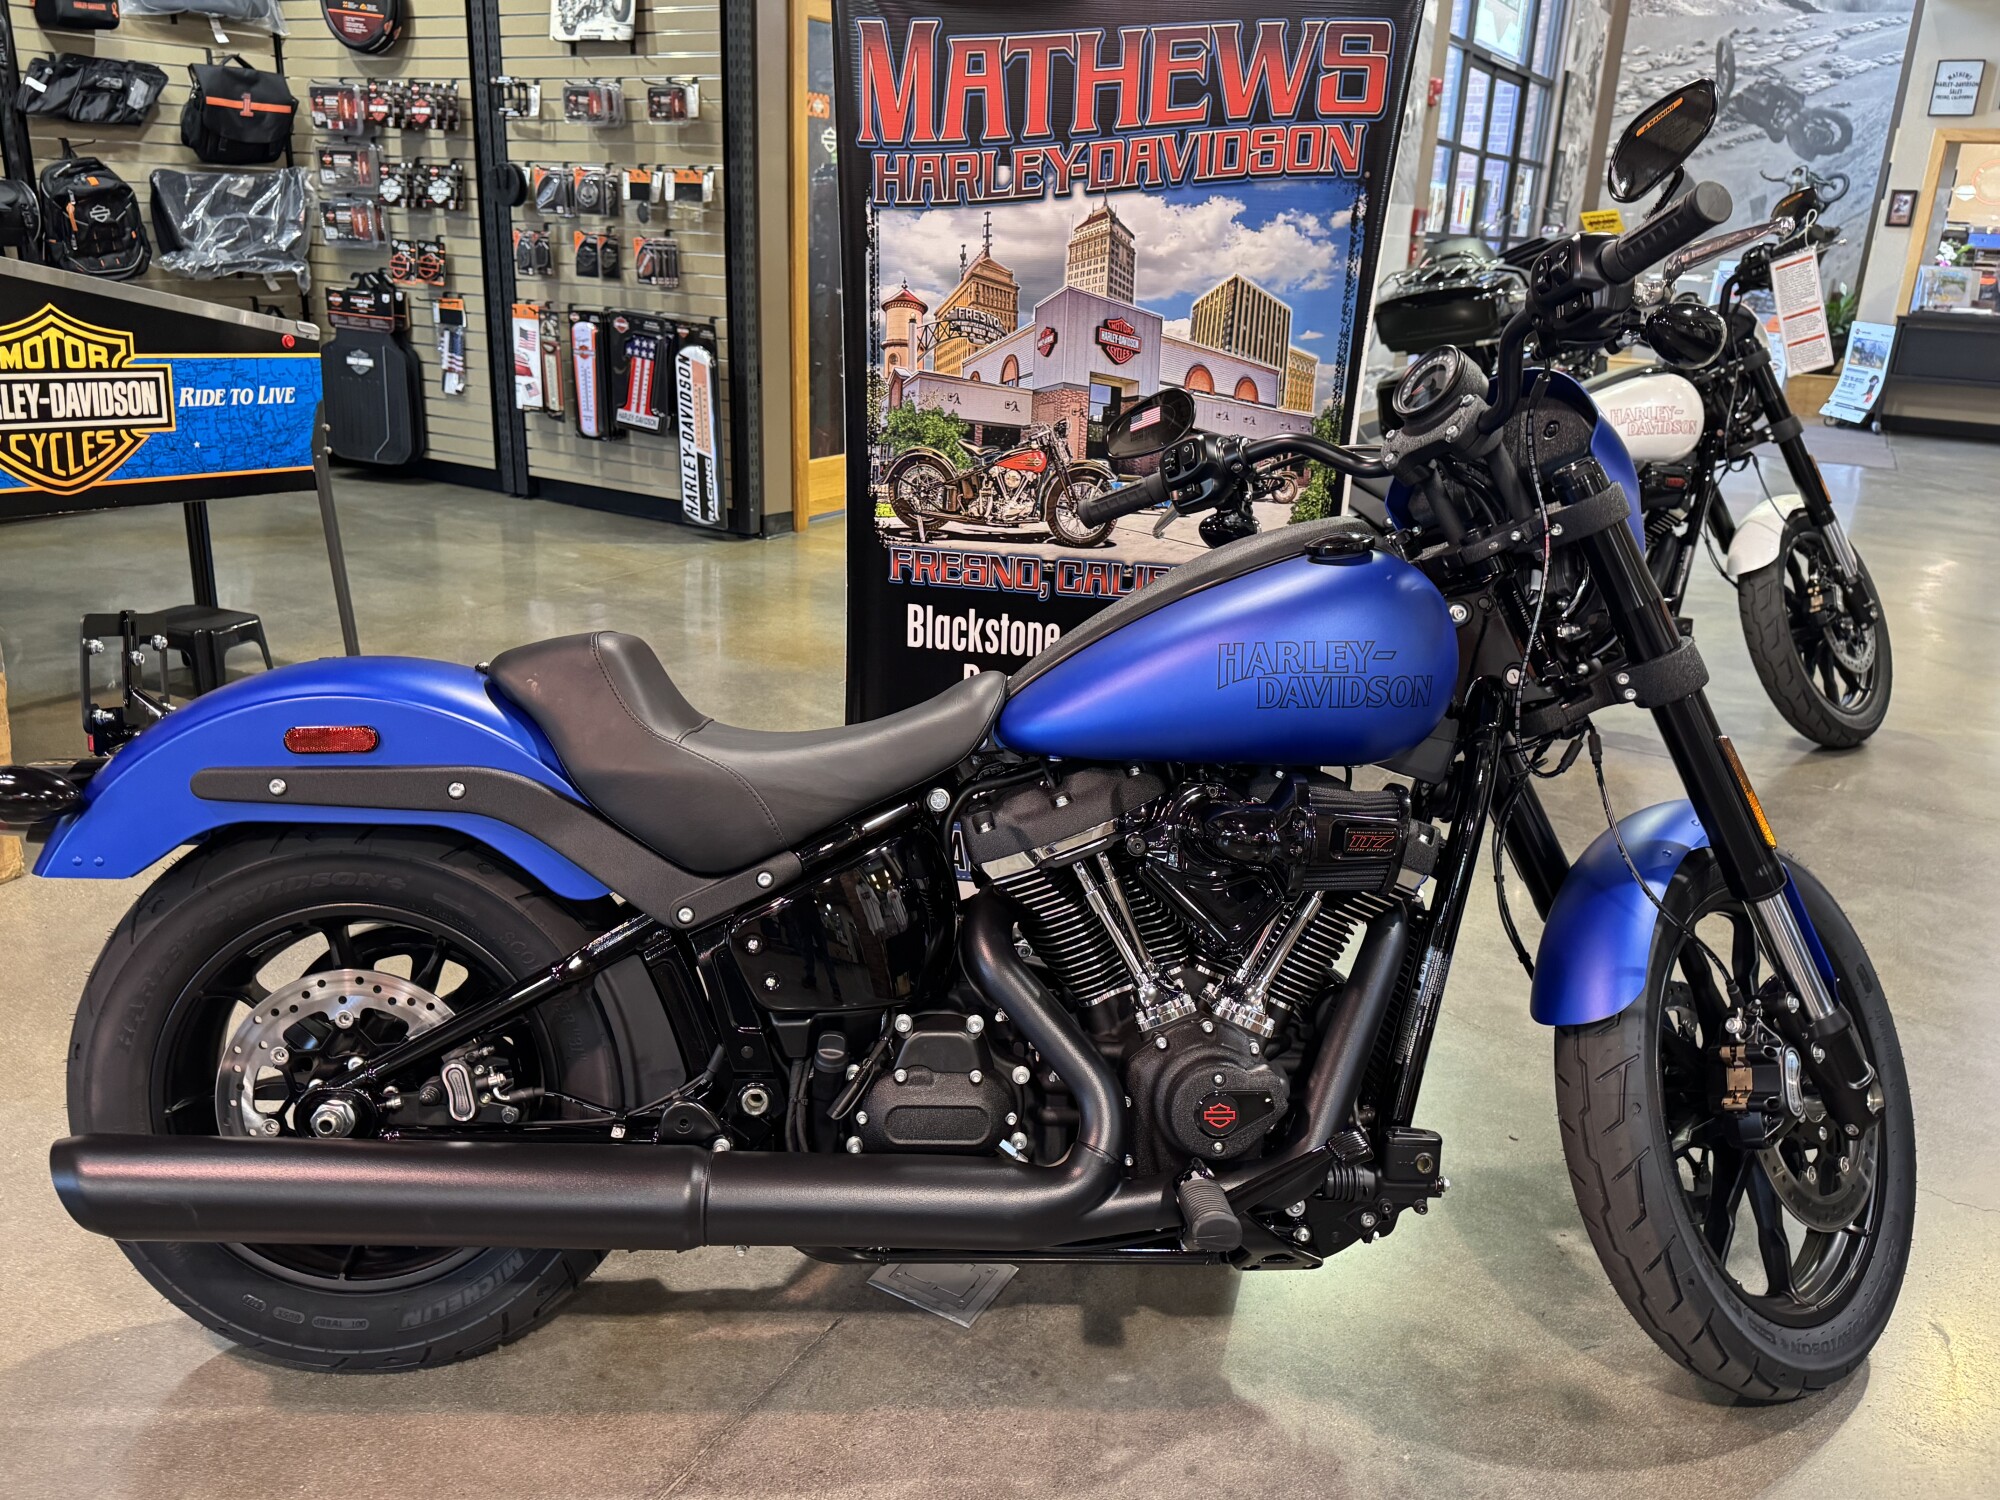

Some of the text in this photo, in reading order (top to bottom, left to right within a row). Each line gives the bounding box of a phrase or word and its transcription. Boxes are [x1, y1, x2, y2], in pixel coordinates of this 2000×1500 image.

[857, 18, 1393, 146] MATHEWS
[872, 124, 1366, 205] HARLEY-DAVIDSON
[957, 307, 1001, 329] FRESNO
[1111, 321, 1132, 334] MOTOR
[0, 327, 109, 369] MOTOR
[0, 380, 158, 421] LEY-DAVIDSON
[178, 385, 296, 408] RIDE TO LIVE
[1610, 406, 1684, 427] HARLEY-
[679, 354, 700, 517] HARLEY-DAVIDSON
[1627, 420, 1698, 437] DAVIDSON
[9, 429, 117, 477] CYCLES
[705, 457, 717, 523] RACING
[888, 547, 1182, 599] FRESNO, CALIF
[906, 603, 1061, 657] Blackstone
[1217, 640, 1397, 691] HARLEY-
[1256, 674, 1433, 710] DAVIDSON
[1349, 834, 1395, 848] 117
[400, 1249, 525, 1328] MICHELIN
